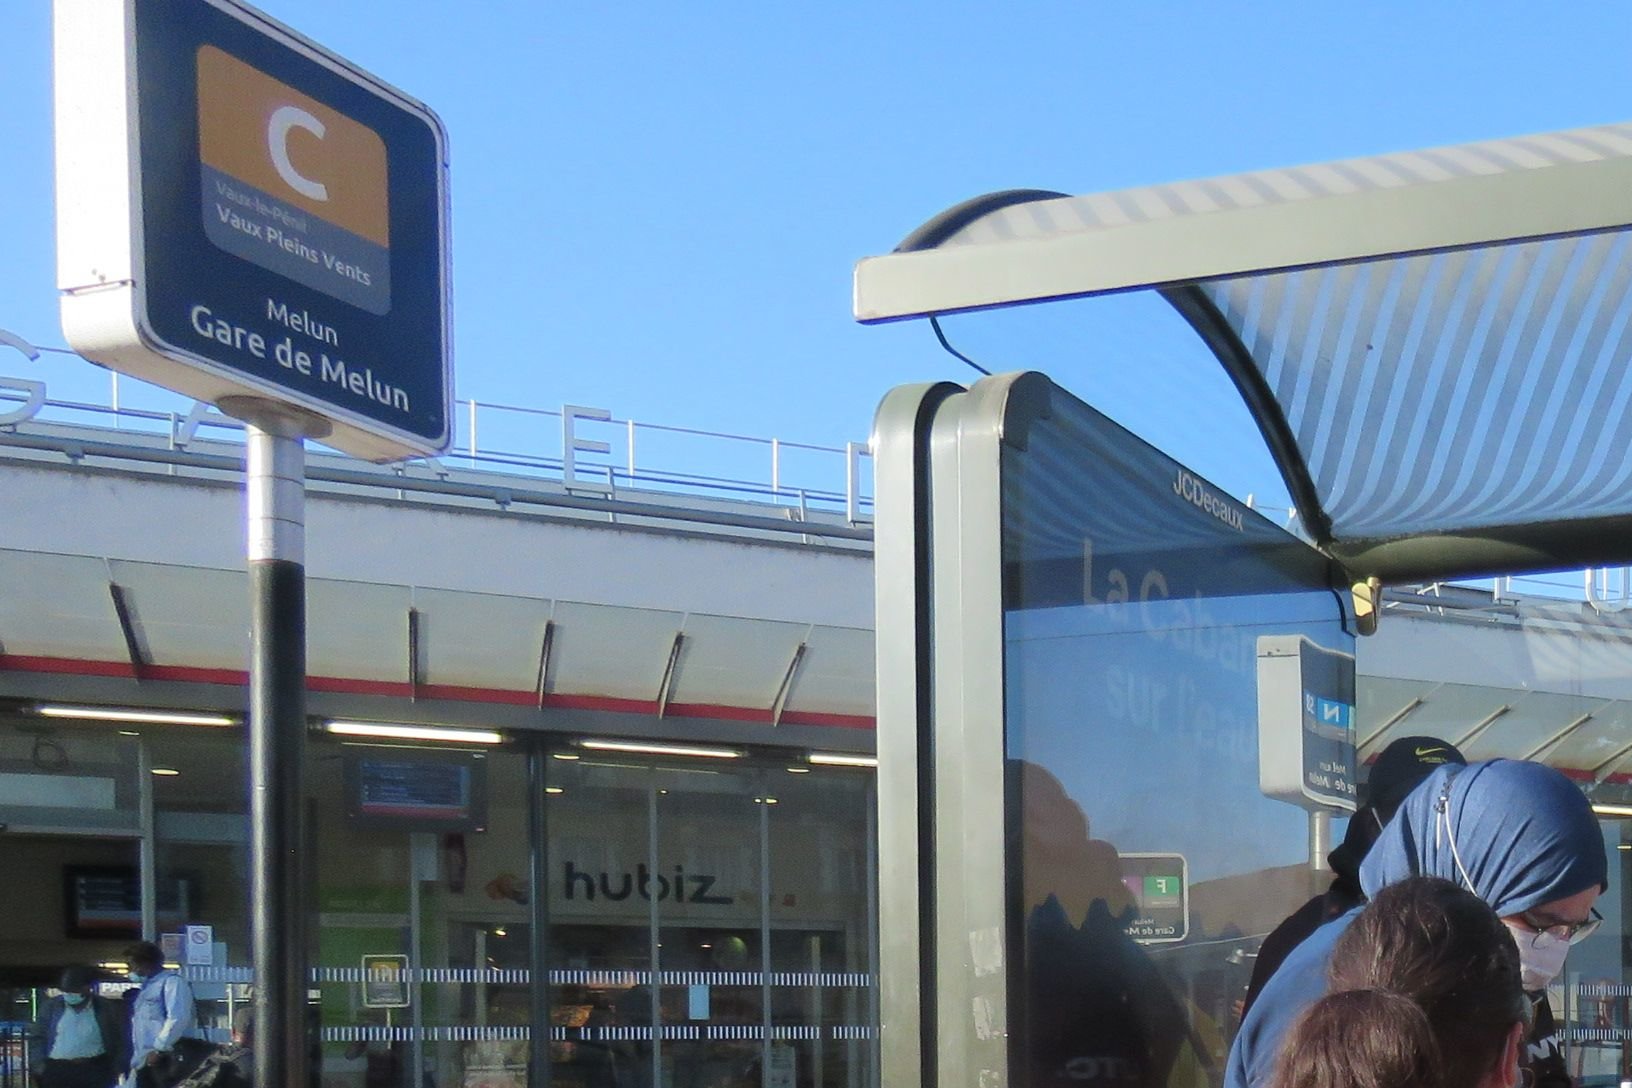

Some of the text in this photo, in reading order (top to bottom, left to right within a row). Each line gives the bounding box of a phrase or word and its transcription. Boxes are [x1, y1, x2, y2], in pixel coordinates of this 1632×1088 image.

[267, 105, 328, 201] C
[216, 203, 372, 287] Vaux Pleins Vents
[191, 305, 411, 413] Gare de Melun
[266, 298, 339, 347] Melun
[1172, 469, 1244, 532] JCDecaux
[564, 861, 734, 904] hubiz
